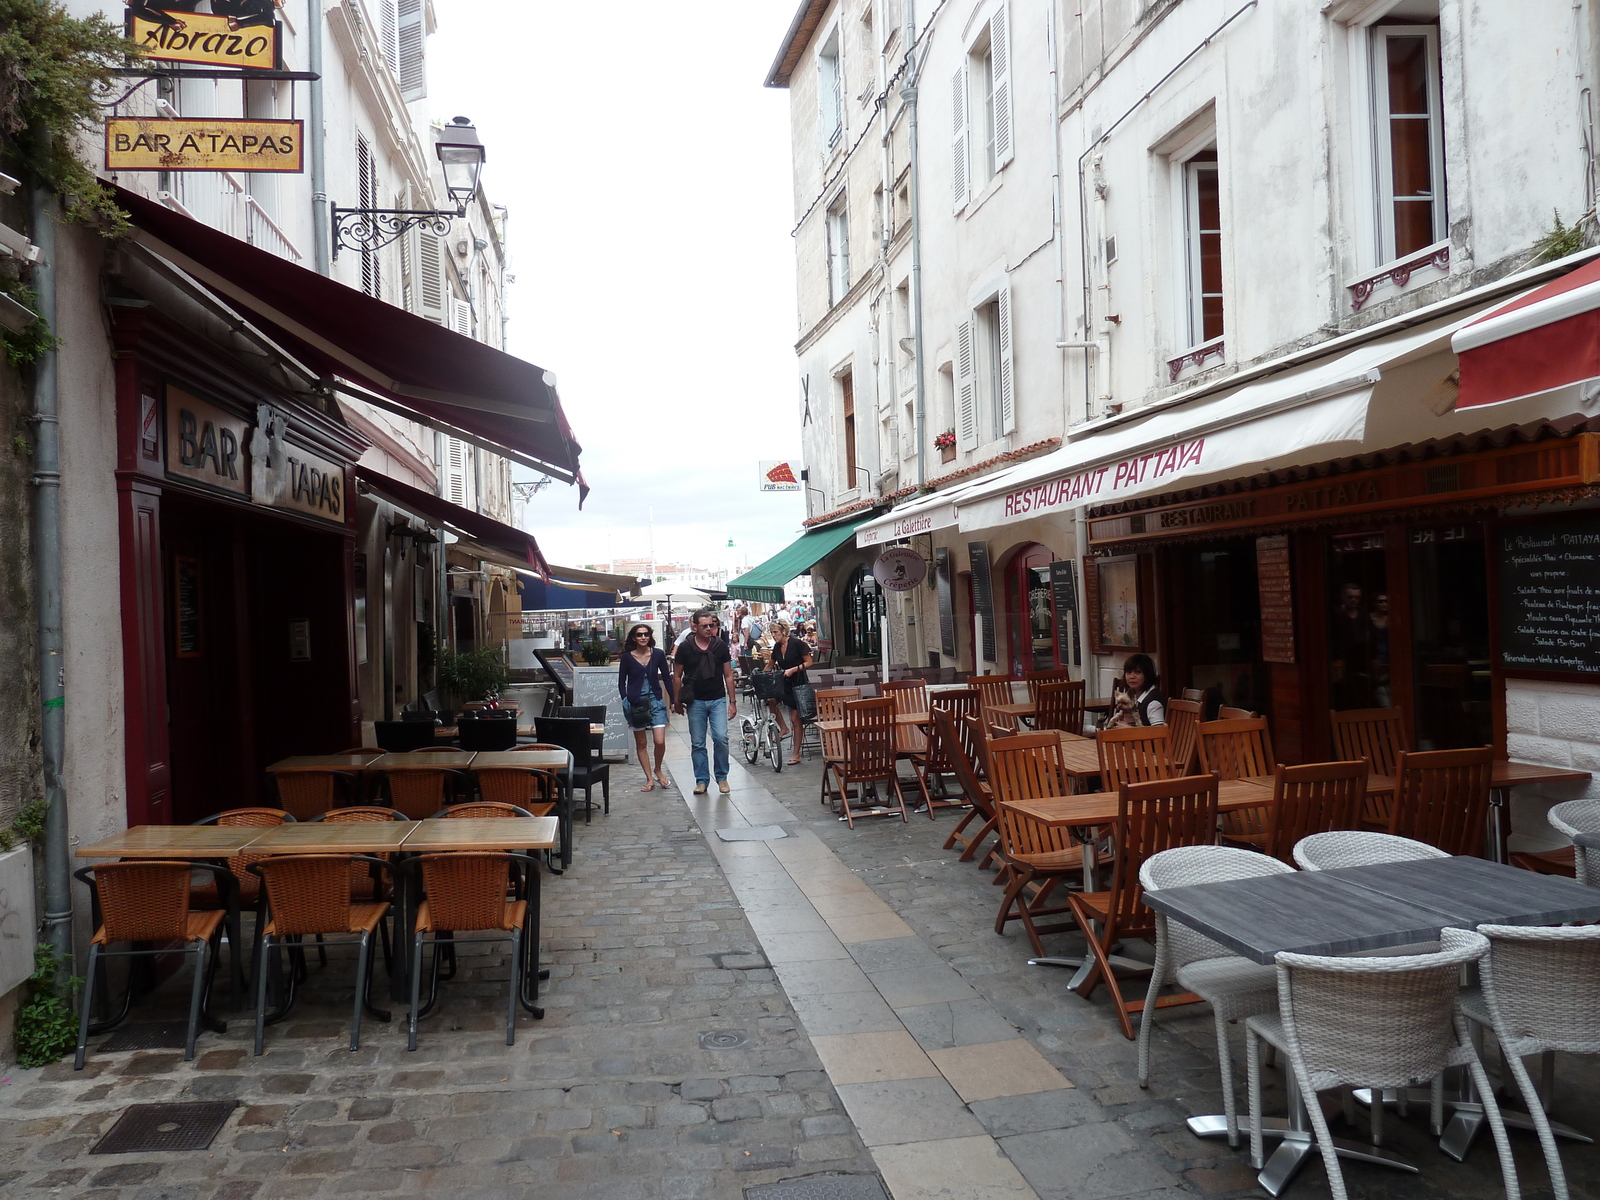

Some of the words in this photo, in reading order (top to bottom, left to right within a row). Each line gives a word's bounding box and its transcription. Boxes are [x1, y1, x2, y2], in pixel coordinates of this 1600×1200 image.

[115, 133, 171, 152] BAR
[207, 135, 294, 154] TAPAS
[181, 408, 238, 481] BAR
[288, 456, 341, 516] TAPAS
[1005, 467, 1109, 517] RESTAURANT
[1113, 438, 1205, 490] PATTAYA
[1160, 500, 1254, 528] RESTAURANT
[1286, 481, 1380, 512] PATTAYA
[893, 522, 901, 537] La
[902, 513, 932, 534] Galettière
[1504, 538, 1513, 551] Le
[1515, 533, 1557, 549] Restaurant
[1560, 533, 1600, 546] PATTAYA
[880, 555, 889, 564] La
[883, 577, 919, 590] Crêperie
[1516, 585, 1537, 595] Salade
[1517, 625, 1536, 634] Salade
[1534, 636, 1555, 646] Salade
[1556, 638, 1586, 648] Bo-Bun
